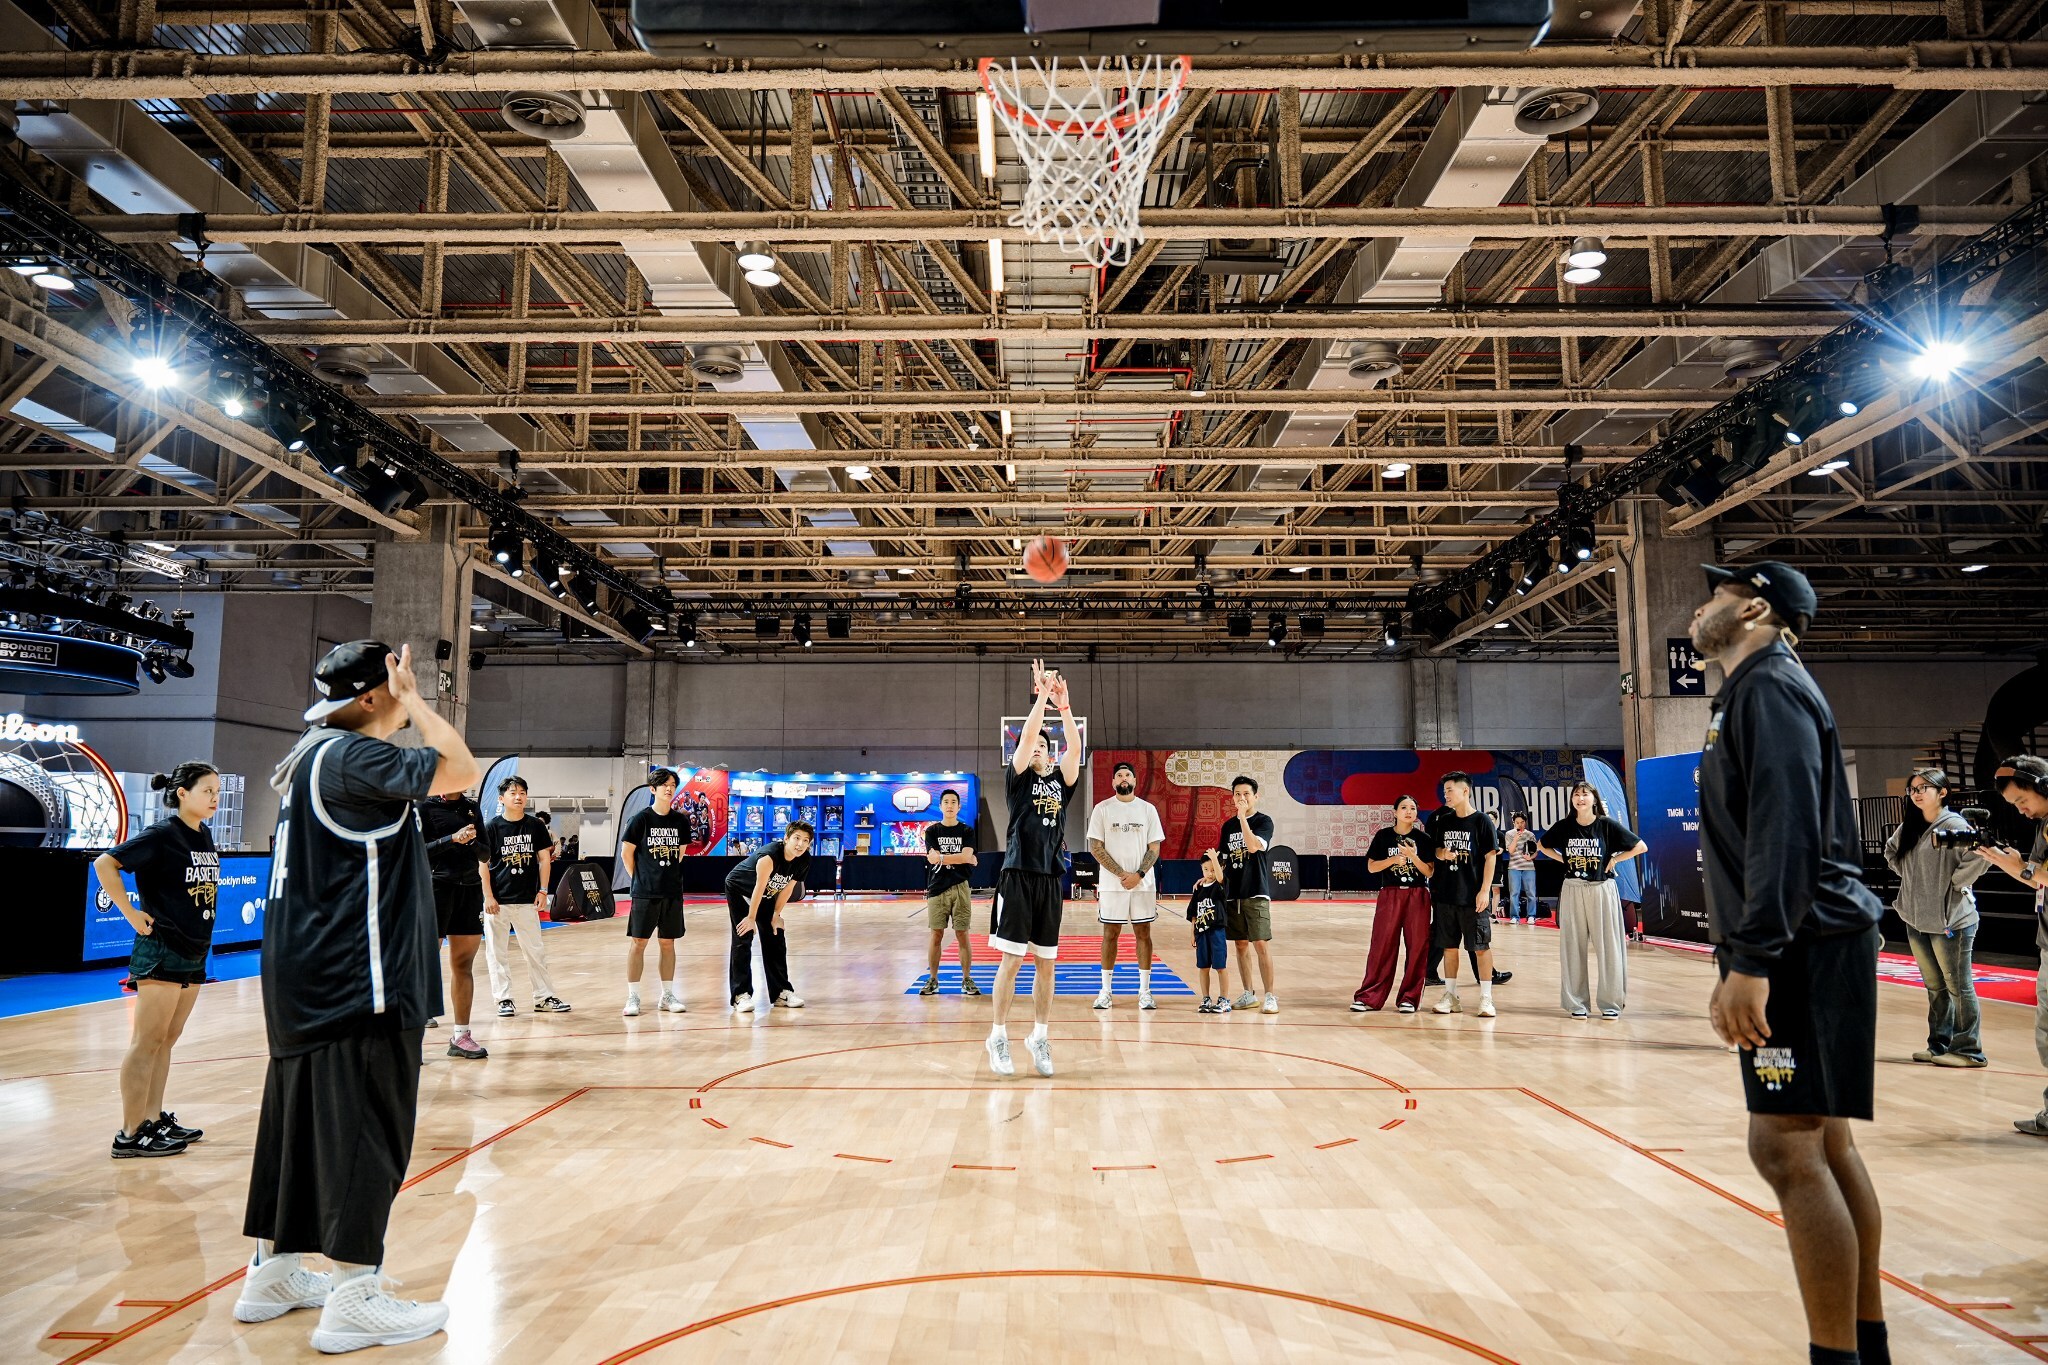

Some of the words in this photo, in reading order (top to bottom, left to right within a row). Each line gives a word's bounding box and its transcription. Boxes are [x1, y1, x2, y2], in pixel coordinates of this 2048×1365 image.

[0, 642, 53, 653] BONDED
[0, 649, 17, 657] BY
[20, 651, 52, 661] BALL
[1667, 807, 1685, 818] TMGM
[650, 827, 679, 837] BROOKLYN
[1444, 830, 1471, 841] BROOKLYN
[503, 834, 532, 846] BROOKLYN
[937, 836, 963, 846] BROOKLYN
[1567, 838, 1600, 848] BROOKLYN
[501, 843, 535, 856] BASKETBALL
[241, 875, 257, 885] Nets
